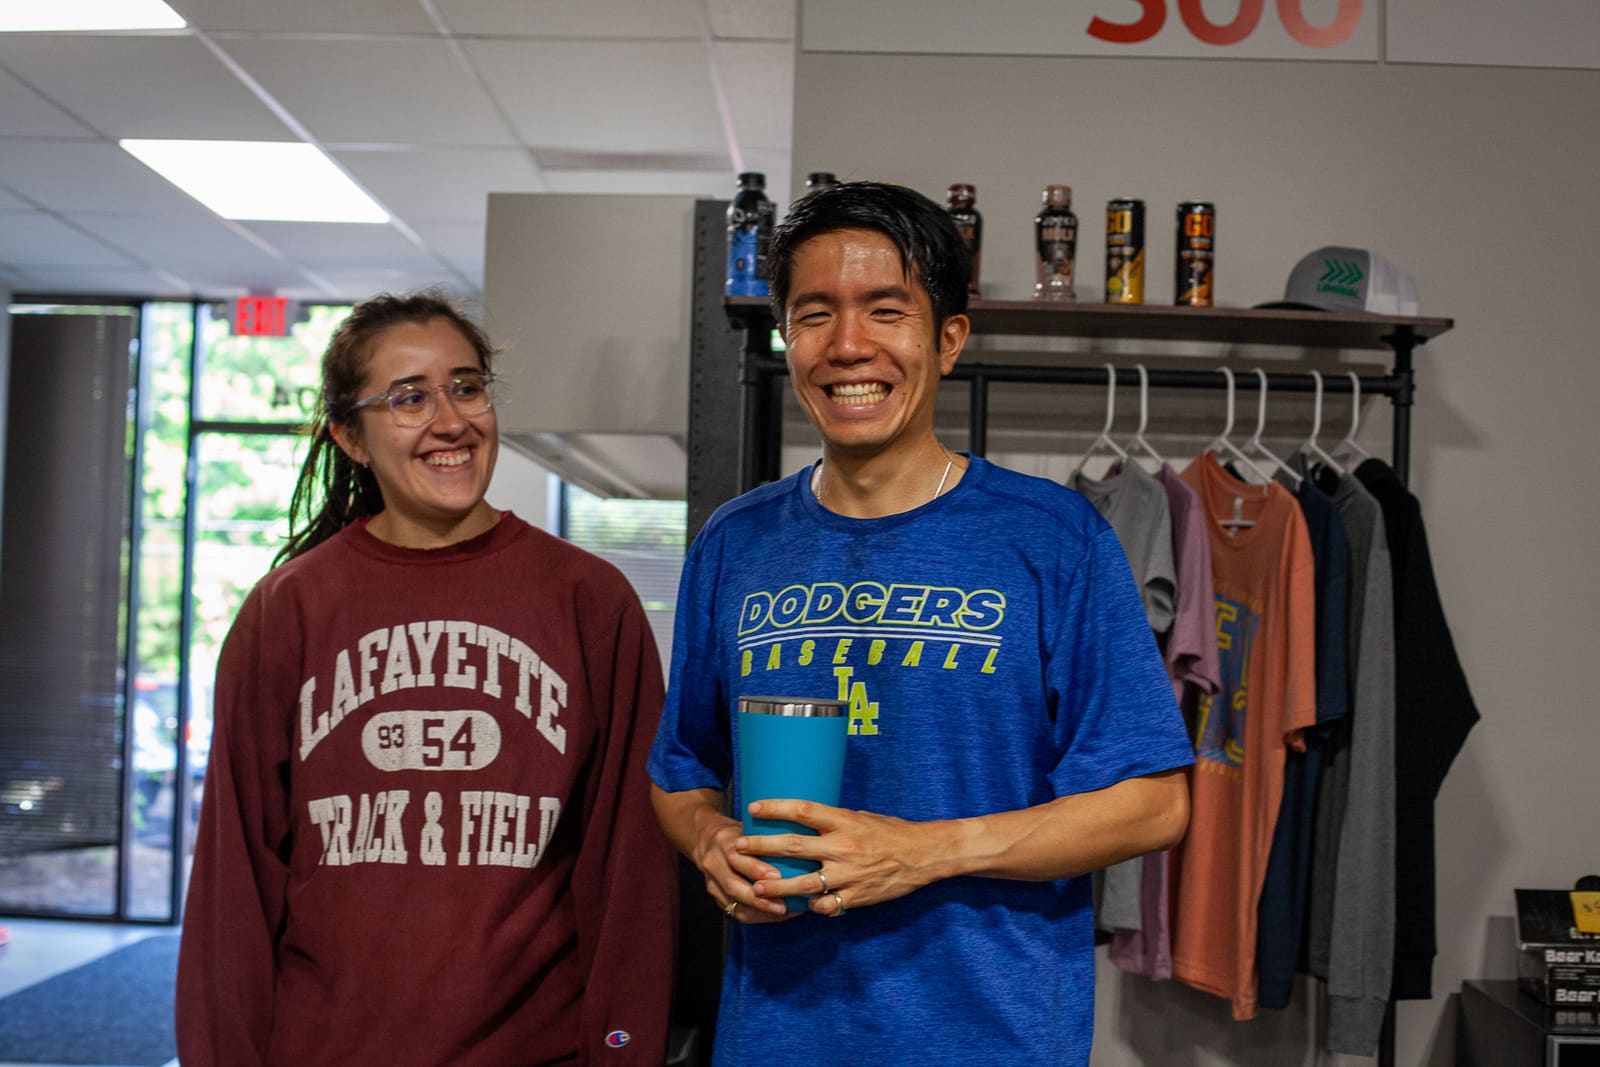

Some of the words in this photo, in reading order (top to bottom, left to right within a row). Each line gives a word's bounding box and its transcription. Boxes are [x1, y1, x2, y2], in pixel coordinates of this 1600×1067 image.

[236, 297, 288, 337] EXIT
[737, 581, 1006, 636] DODGERS
[741, 639, 999, 677] BASEBALL
[299, 620, 568, 762] LAFAYETTE
[378, 724, 405, 749] 93
[422, 716, 476, 767] 54
[308, 790, 410, 866] TRACK
[420, 791, 447, 866] &
[458, 791, 561, 868] FIELD
[1585, 950, 1600, 963] K
